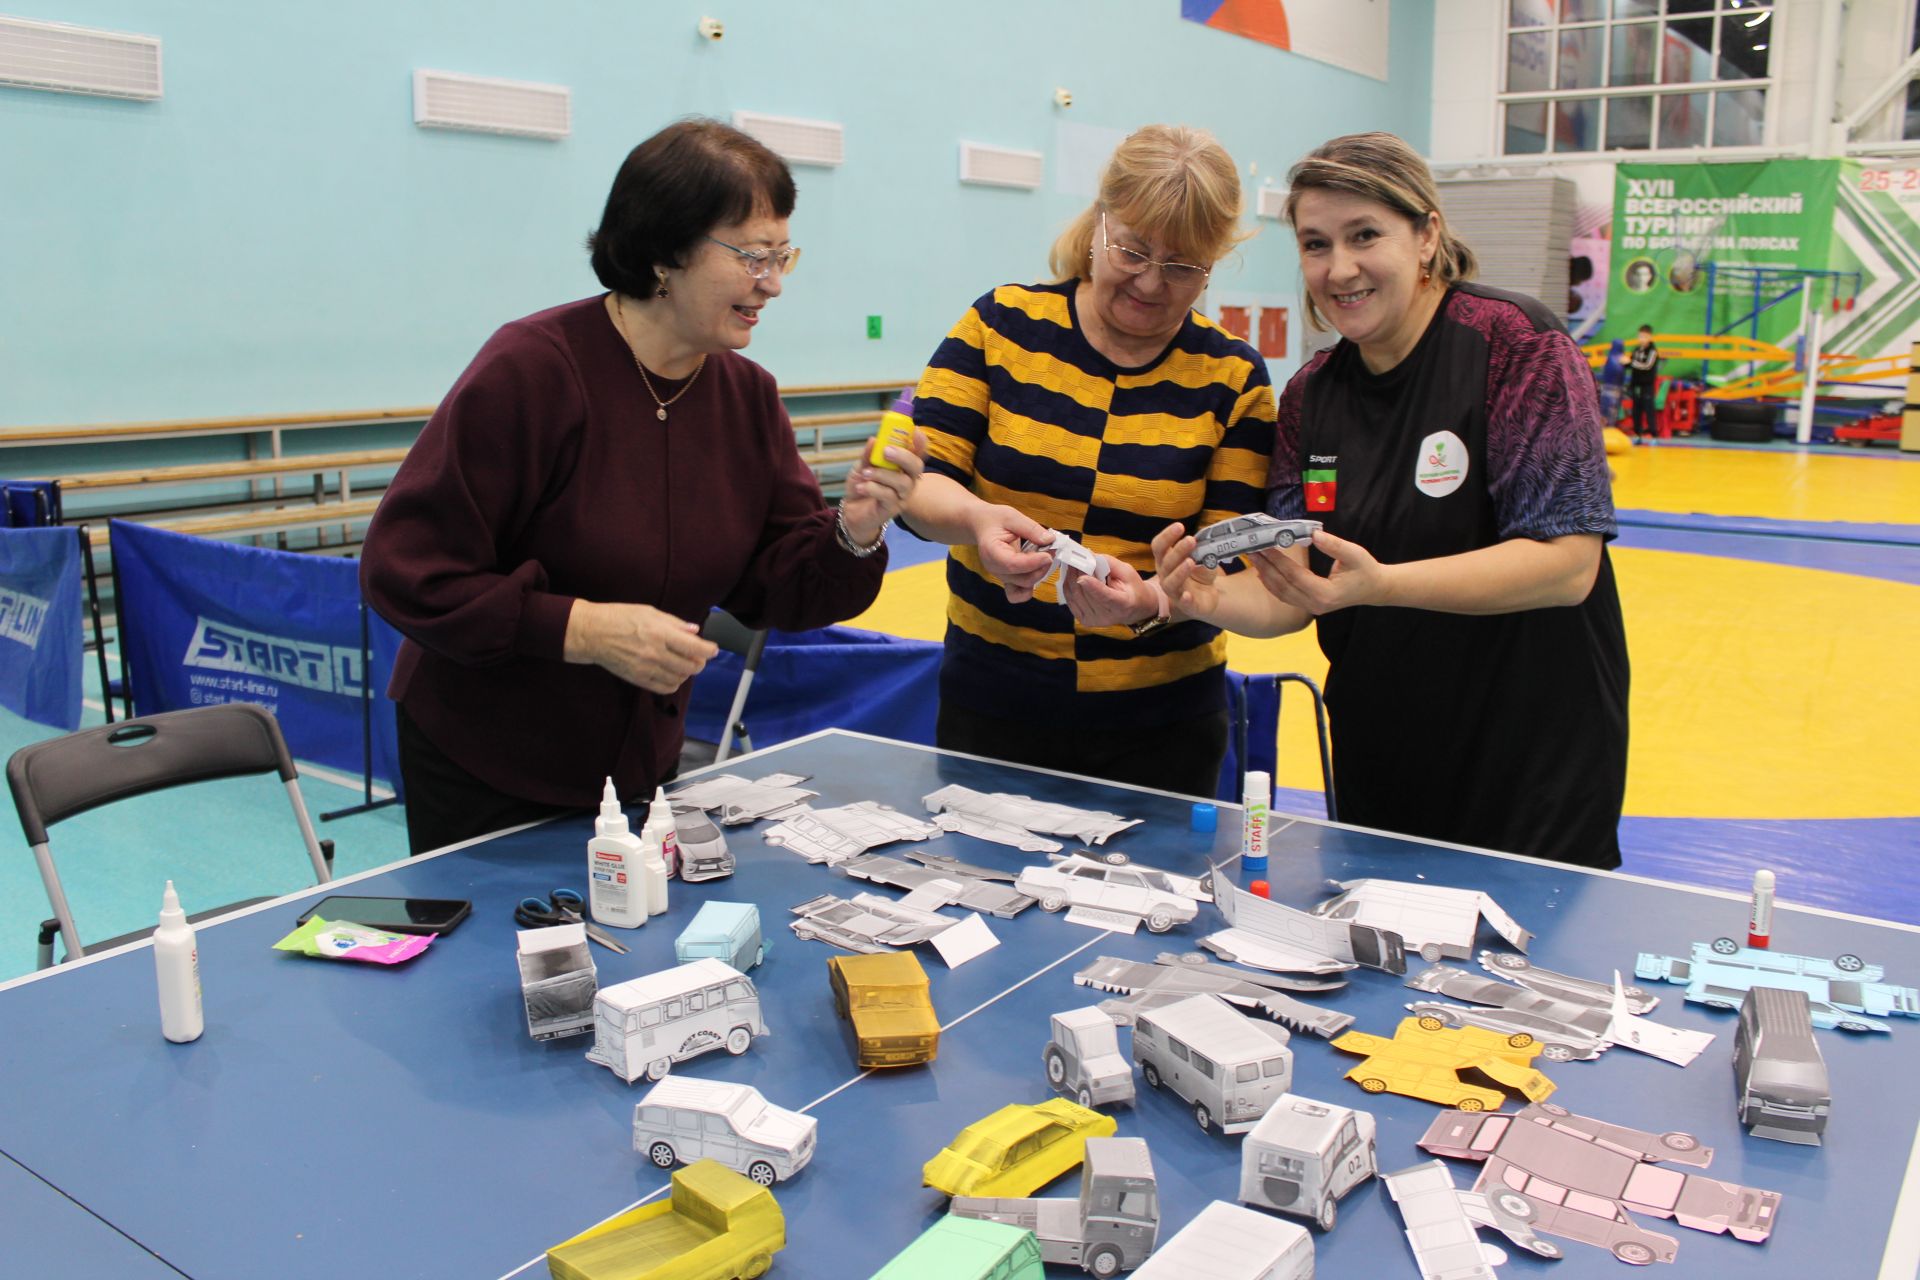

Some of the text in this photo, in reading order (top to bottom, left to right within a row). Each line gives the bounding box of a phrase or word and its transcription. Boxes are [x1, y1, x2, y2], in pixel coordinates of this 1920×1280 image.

[1626, 179, 1675, 197] XVII
[1625, 193, 1803, 215] ВСЕРОССИЙСКИЙ
[1622, 236, 1646, 249] ПО
[1309, 455, 1338, 464] SPORT
[198, 626, 325, 683] START
[190, 674, 278, 698] www.start-line.ru
[1251, 815, 1262, 852] STAFF
[679, 1030, 722, 1053] WEST COAST
[1348, 1155, 1362, 1175] 02
